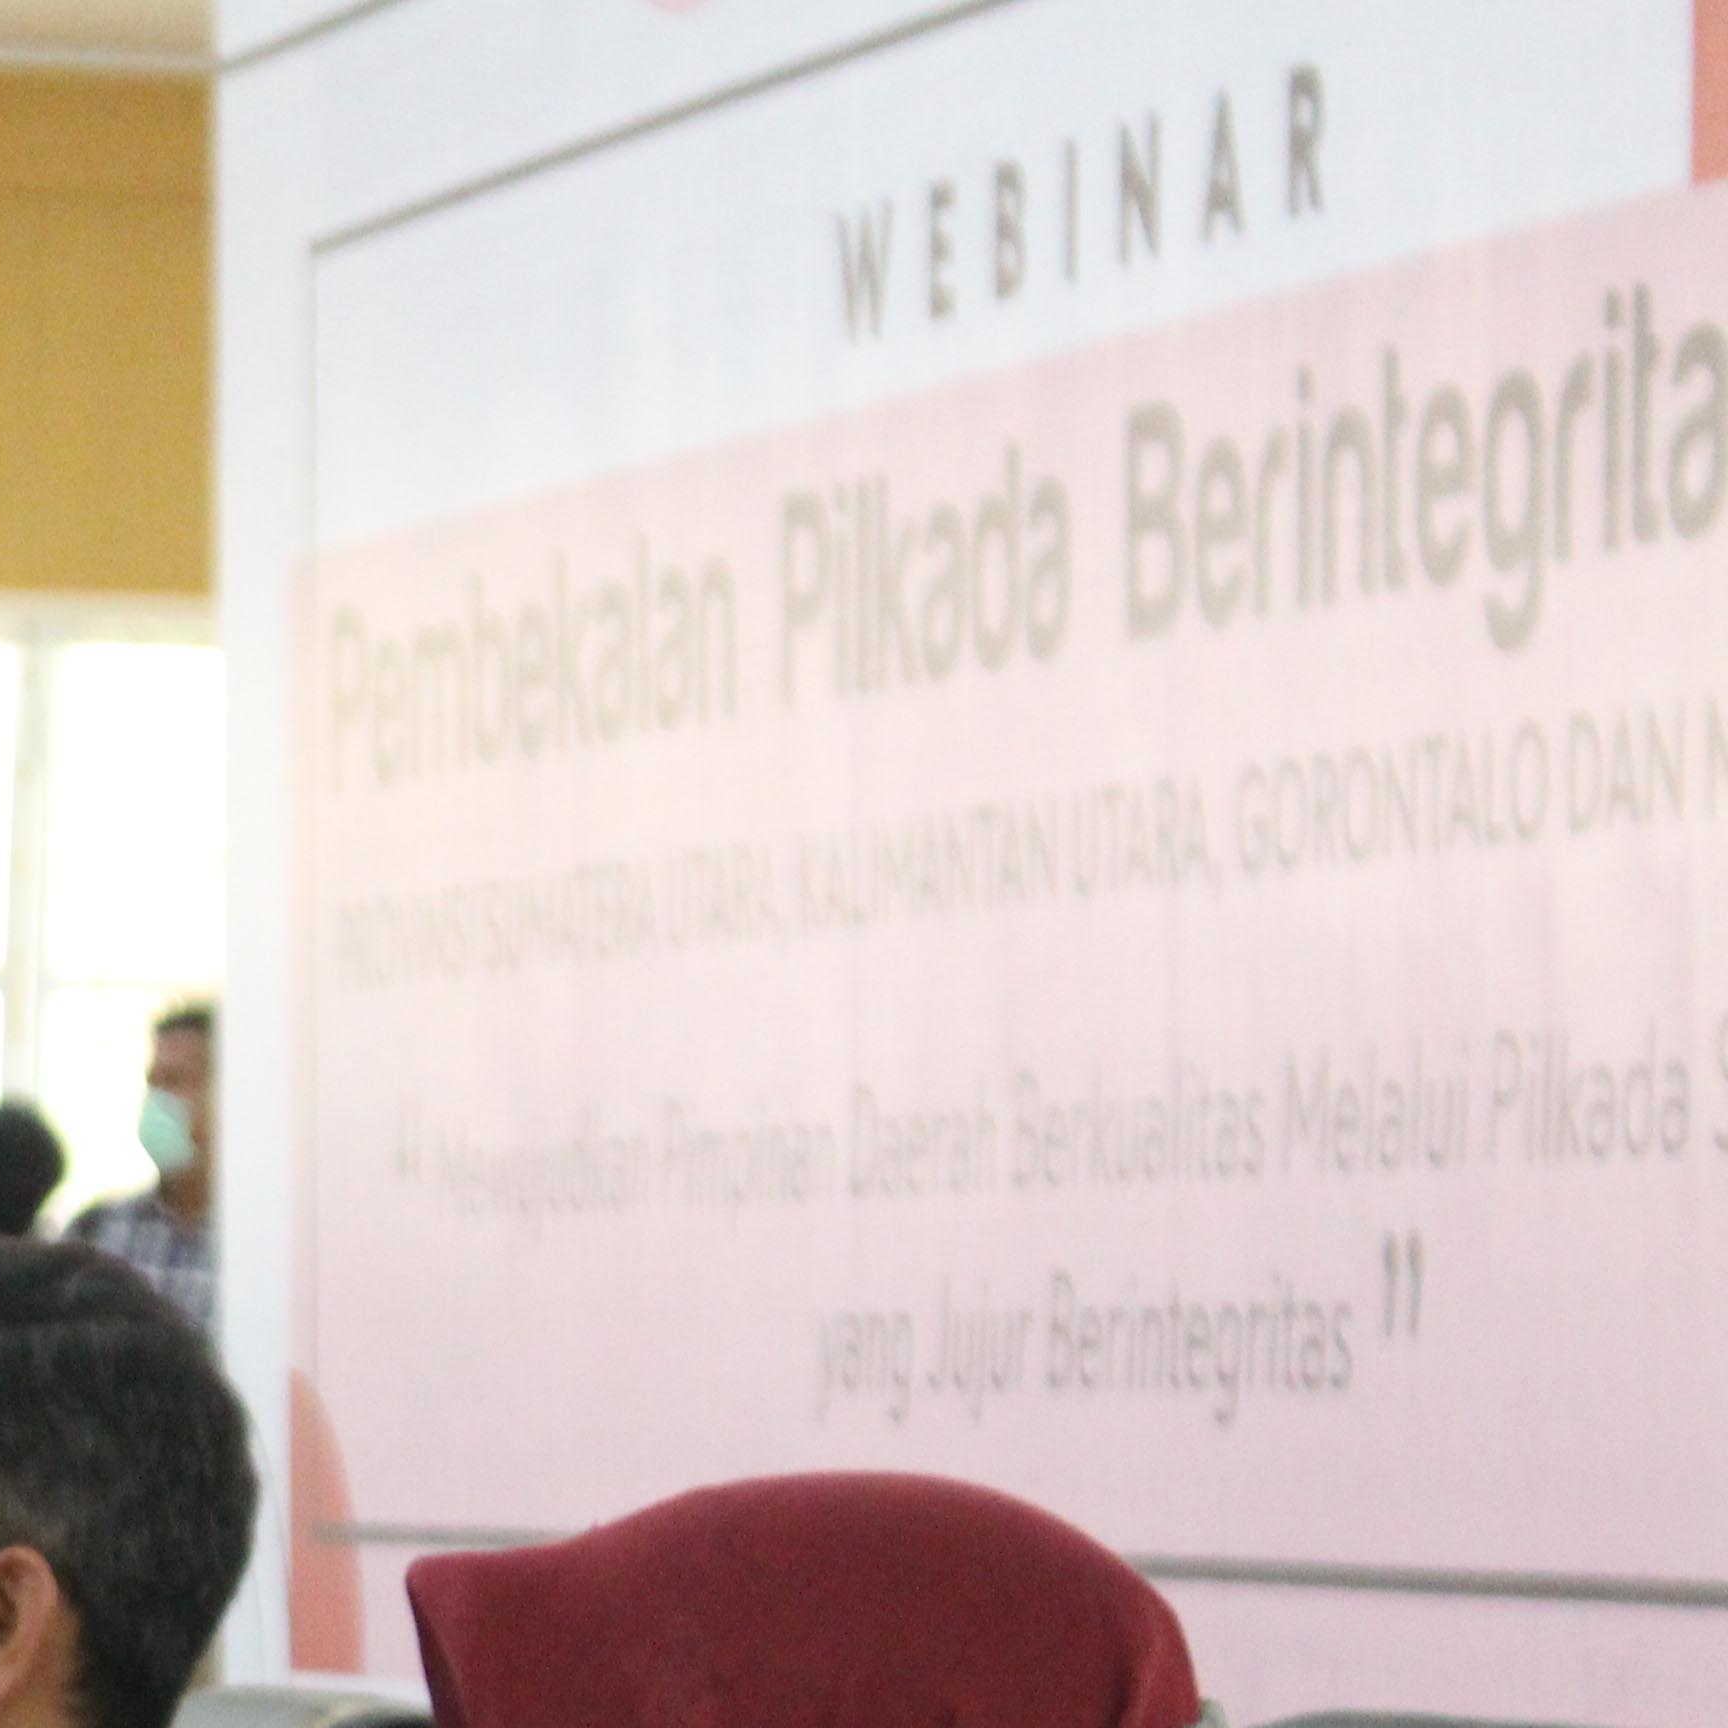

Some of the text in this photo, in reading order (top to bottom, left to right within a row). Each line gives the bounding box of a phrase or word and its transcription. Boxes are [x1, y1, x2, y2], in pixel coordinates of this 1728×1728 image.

[836, 60, 1325, 344] WEBINAR
[328, 526, 738, 793] Pembekalan
[776, 437, 1072, 706] Pilkada
[1236, 715, 1550, 879] GORONTALO
[1564, 700, 1686, 836] DAN
[847, 1072, 998, 1201] Daerah
[1008, 1050, 1269, 1190] Berkualitas
[1282, 1035, 1472, 1177] Melalui
[1484, 1014, 1692, 1166] Pilkada
[814, 1306, 915, 1428] yang
[924, 1275, 1034, 1426] Jujur
[1046, 1267, 1355, 1431] Berintegritas
